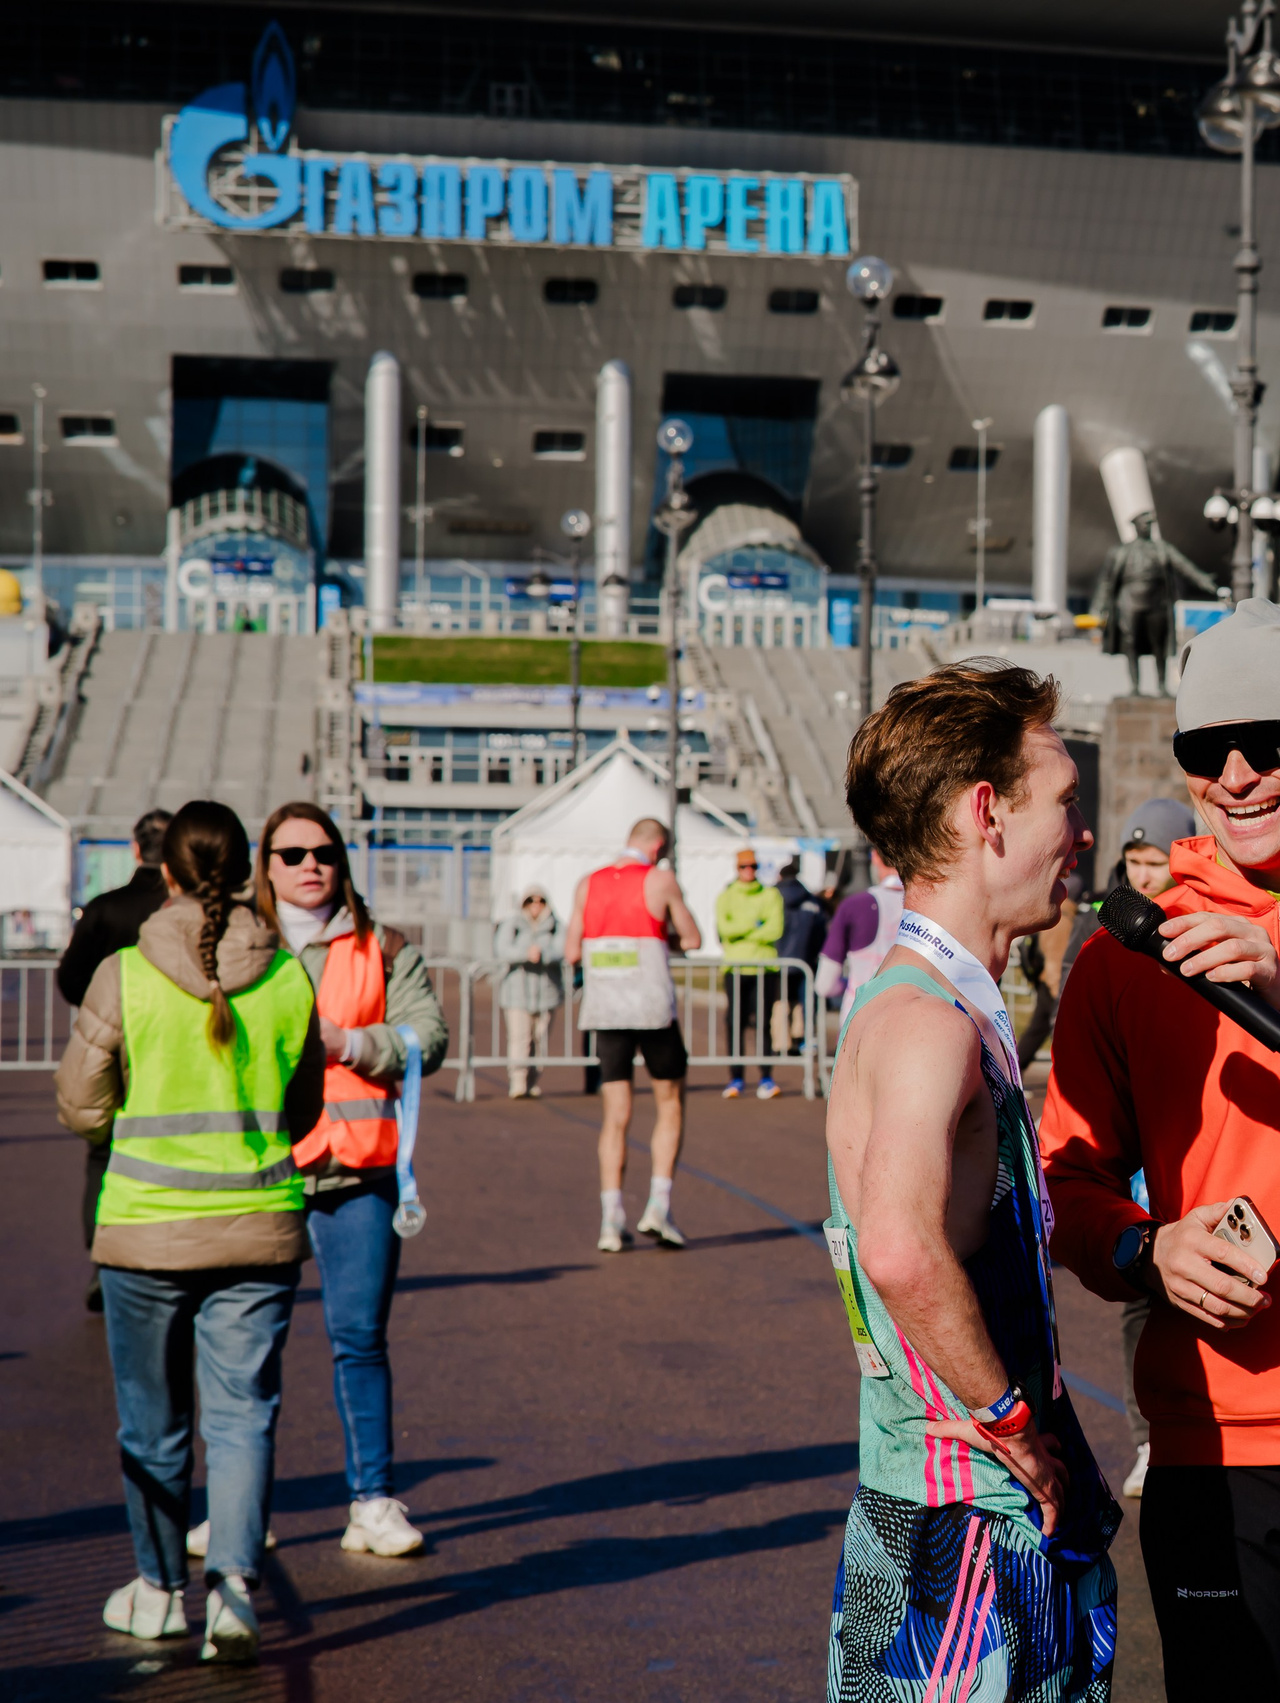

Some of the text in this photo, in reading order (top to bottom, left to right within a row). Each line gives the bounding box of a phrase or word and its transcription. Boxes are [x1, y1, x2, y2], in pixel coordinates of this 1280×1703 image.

[303, 157, 851, 257] ГАЗПРОМ АРЕНА
[1188, 1589, 1239, 1598] NORDSKI
